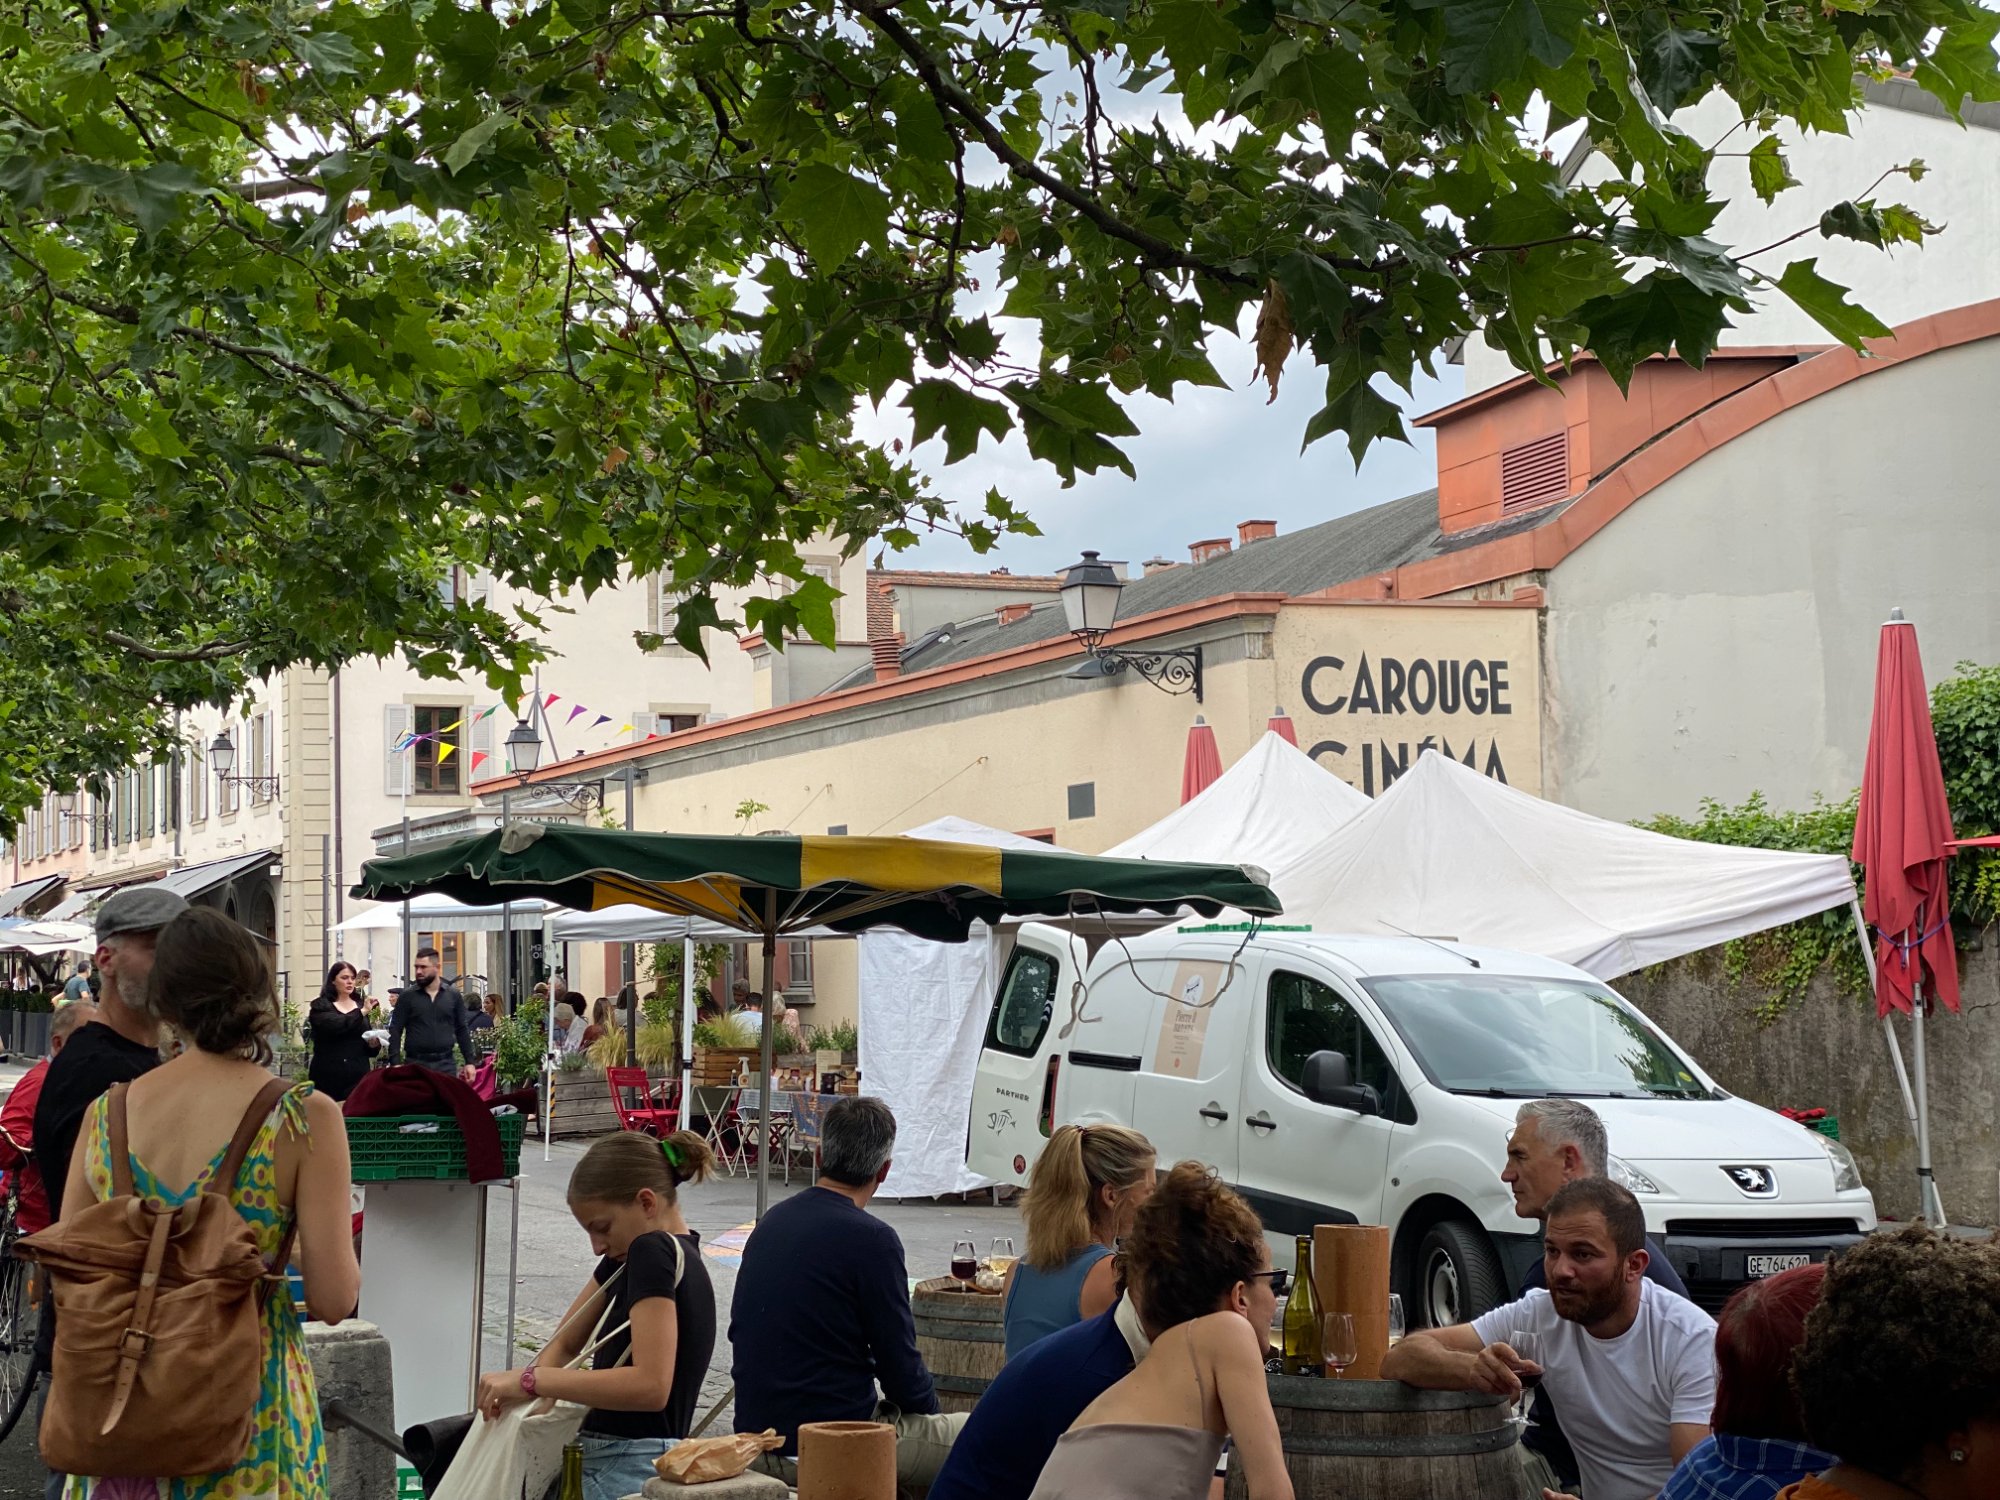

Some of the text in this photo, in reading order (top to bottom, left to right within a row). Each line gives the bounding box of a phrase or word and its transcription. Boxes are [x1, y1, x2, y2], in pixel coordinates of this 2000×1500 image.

[1301, 650, 1512, 715] CAROUGE
[1306, 735, 1509, 799] CINA
[996, 1087, 1030, 1101] PARTNER
